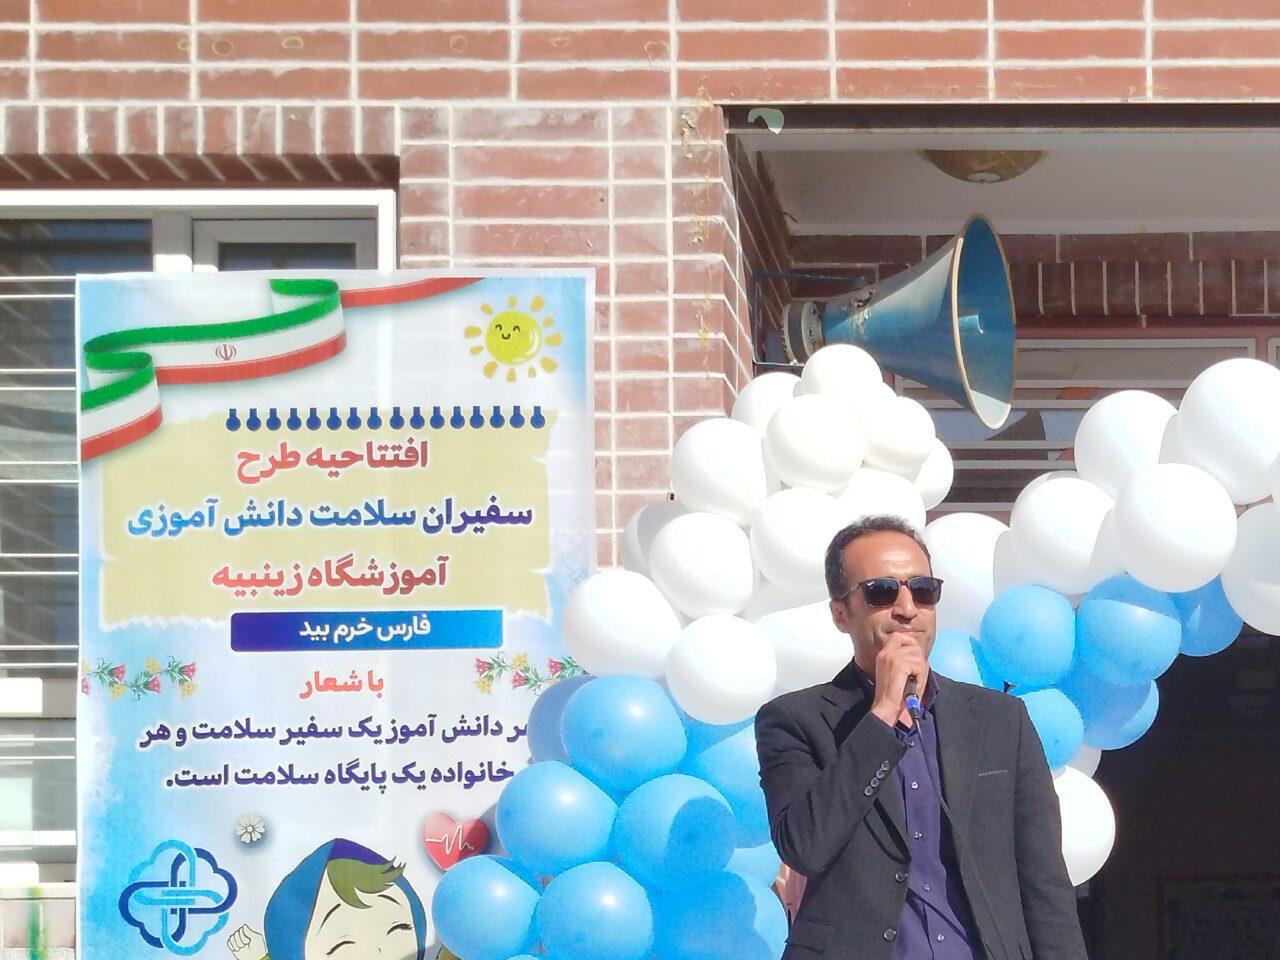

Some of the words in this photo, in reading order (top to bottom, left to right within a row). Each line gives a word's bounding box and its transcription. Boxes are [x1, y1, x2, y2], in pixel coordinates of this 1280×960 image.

[237, 441, 301, 485] طرح
[306, 436, 428, 478] افتتاحیه
[126, 497, 219, 538] آموزی
[223, 497, 304, 537] دانش
[309, 497, 416, 530] سلامت
[422, 494, 533, 535] سفیران
[211, 562, 303, 597] زینبیه
[307, 552, 449, 596] آموزشگاه
[299, 618, 330, 641] بید
[333, 616, 374, 644] خرم
[376, 613, 432, 642] فارس
[299, 670, 363, 699] شعار
[366, 670, 385, 700] با
[139, 725, 171, 748] هر
[175, 725, 188, 747] و
[192, 716, 277, 739] سلامت
[279, 714, 343, 746] سفیر
[347, 715, 384, 745] یک
[389, 713, 437, 744] آموز
[441, 714, 504, 744] دانش
[165, 763, 229, 787] است.
[234, 763, 319, 786] سلامت
[323, 757, 388, 795] پایگاه
[392, 761, 427, 792] یک
[431, 759, 515, 790] خانواده
